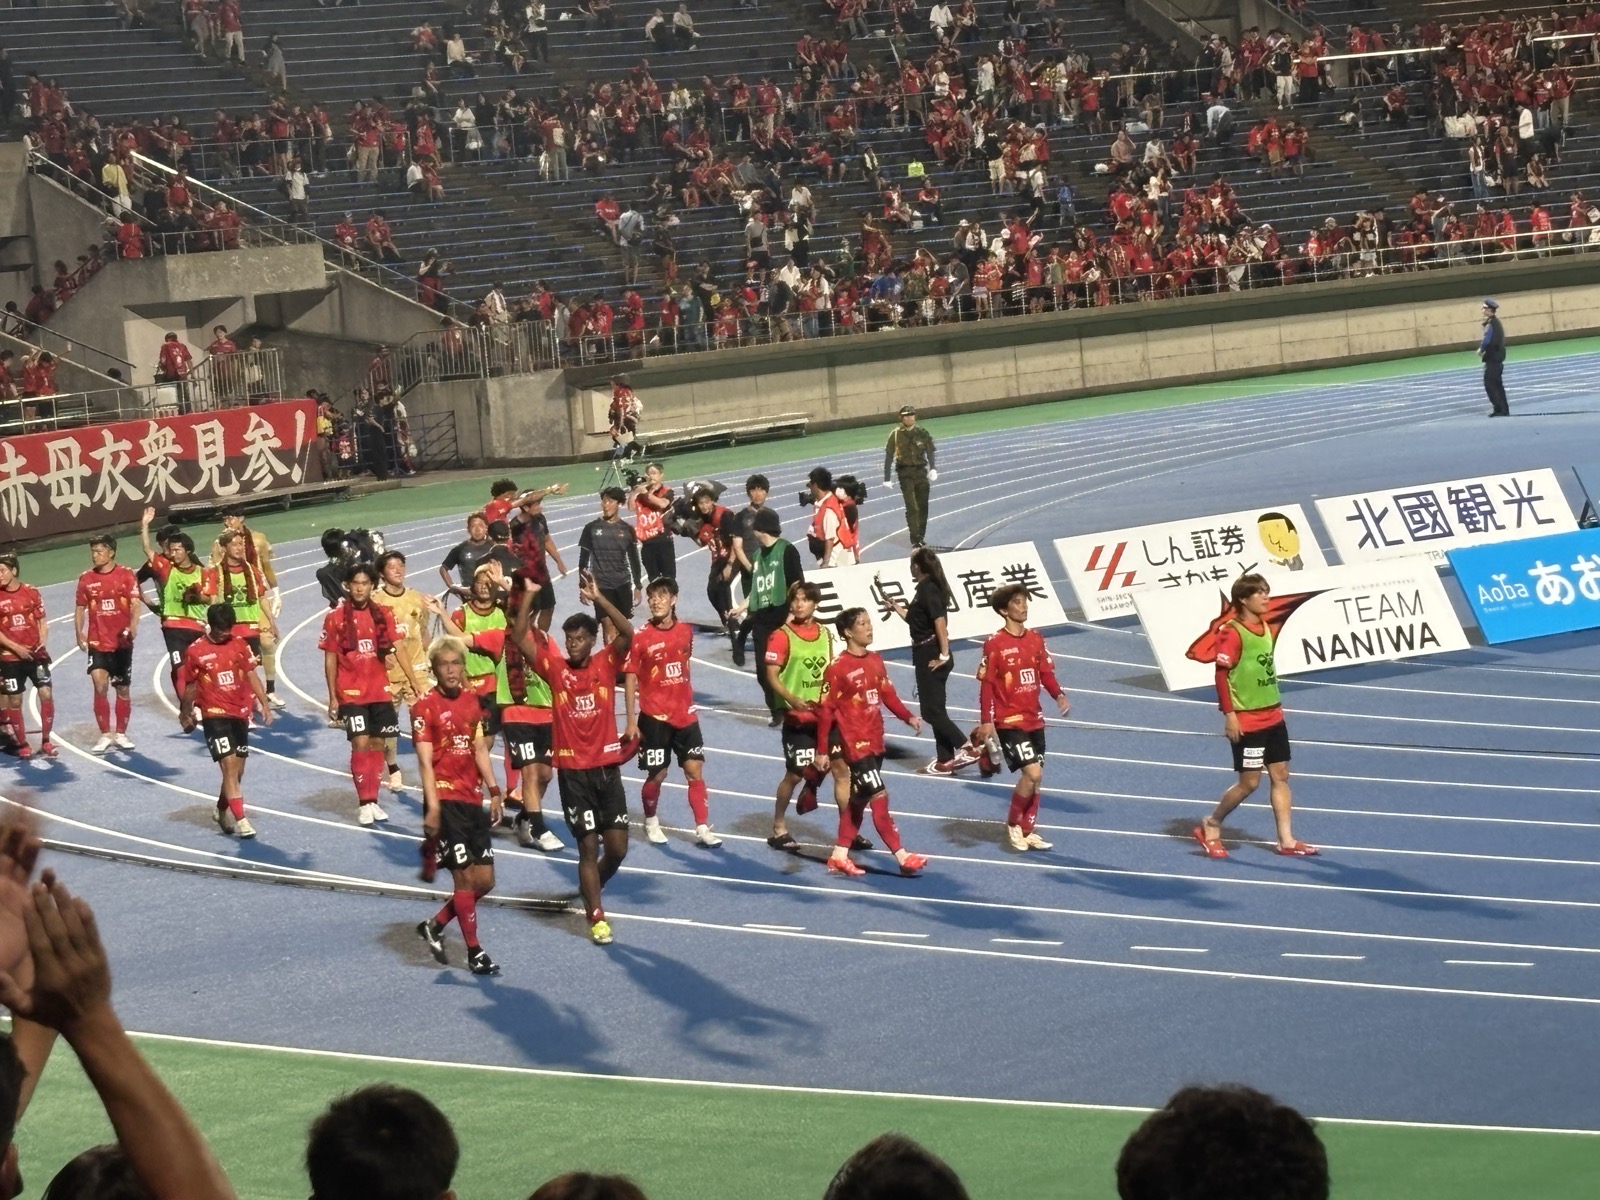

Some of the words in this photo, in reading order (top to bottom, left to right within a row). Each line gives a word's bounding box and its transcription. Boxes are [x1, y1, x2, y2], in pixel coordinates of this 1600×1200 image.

[1346, 477, 1555, 549] 北國観光
[1142, 525, 1246, 566] しん証券
[1478, 575, 1530, 605] Aoba
[1334, 589, 1424, 625] TEAM
[1301, 621, 1441, 665] NANIWA
[215, 737, 231, 754] 13
[519, 742, 535, 760] 18
[1016, 741, 1034, 761] 15
[647, 749, 664, 766] 28
[863, 769, 882, 788] 41
[584, 810, 595, 830] 9
[454, 843, 467, 864] 2
